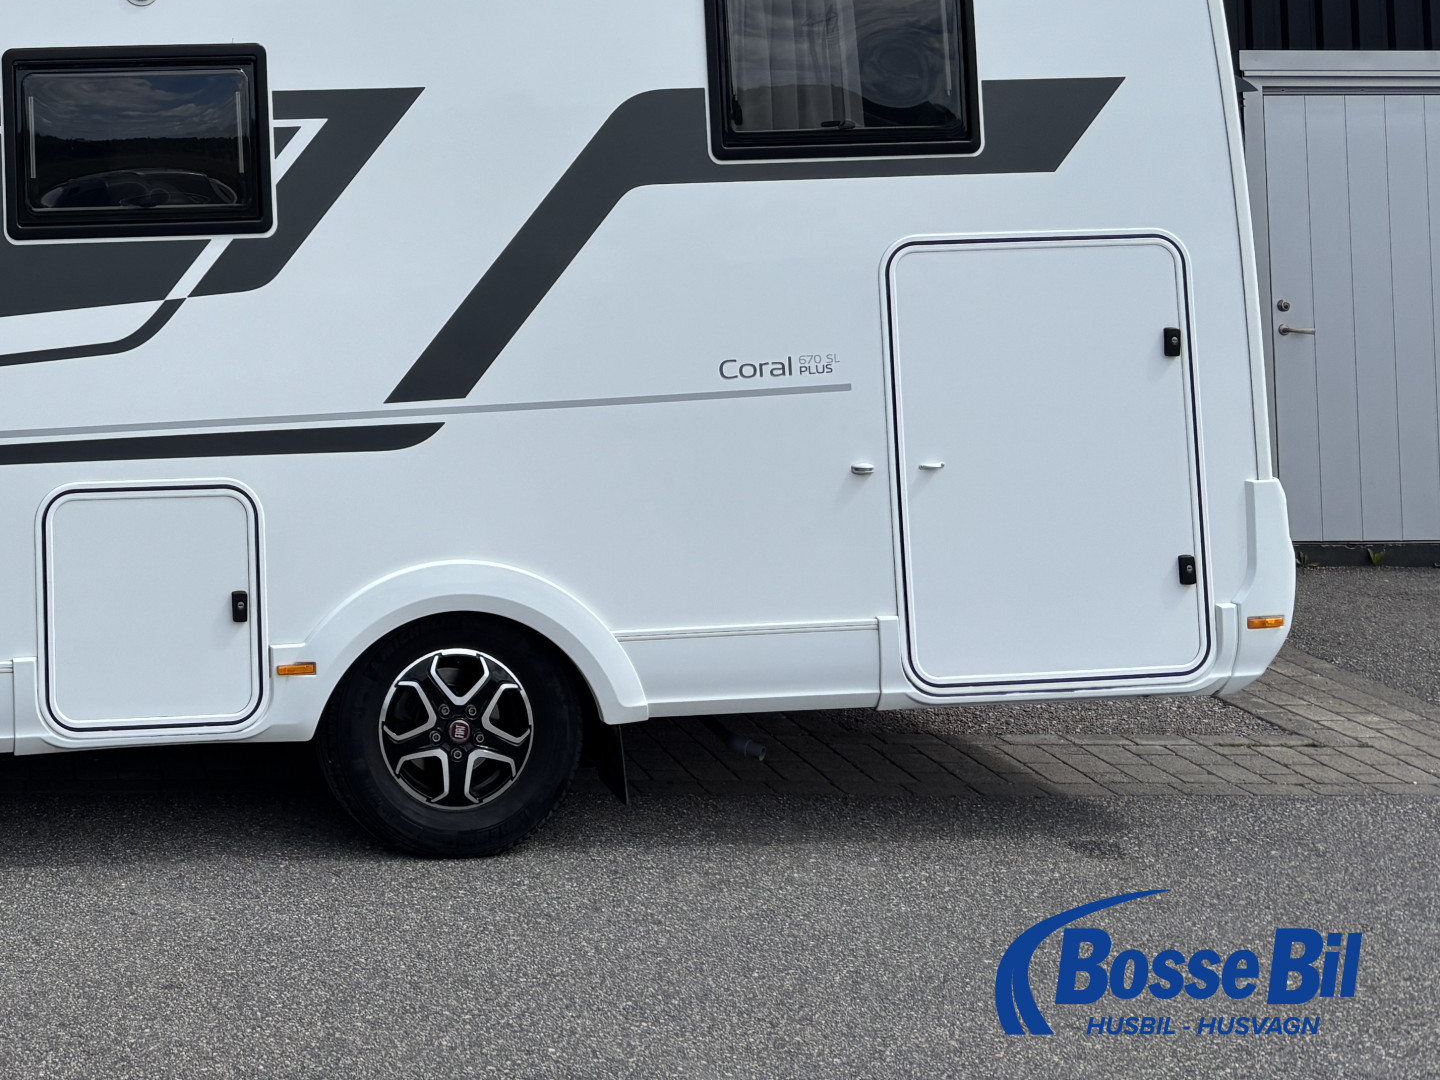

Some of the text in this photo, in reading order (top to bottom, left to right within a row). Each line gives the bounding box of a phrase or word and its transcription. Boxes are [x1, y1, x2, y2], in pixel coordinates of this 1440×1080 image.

[798, 353, 841, 365] 670 SL
[719, 356, 793, 380] Coral
[799, 364, 833, 376] PLUS
